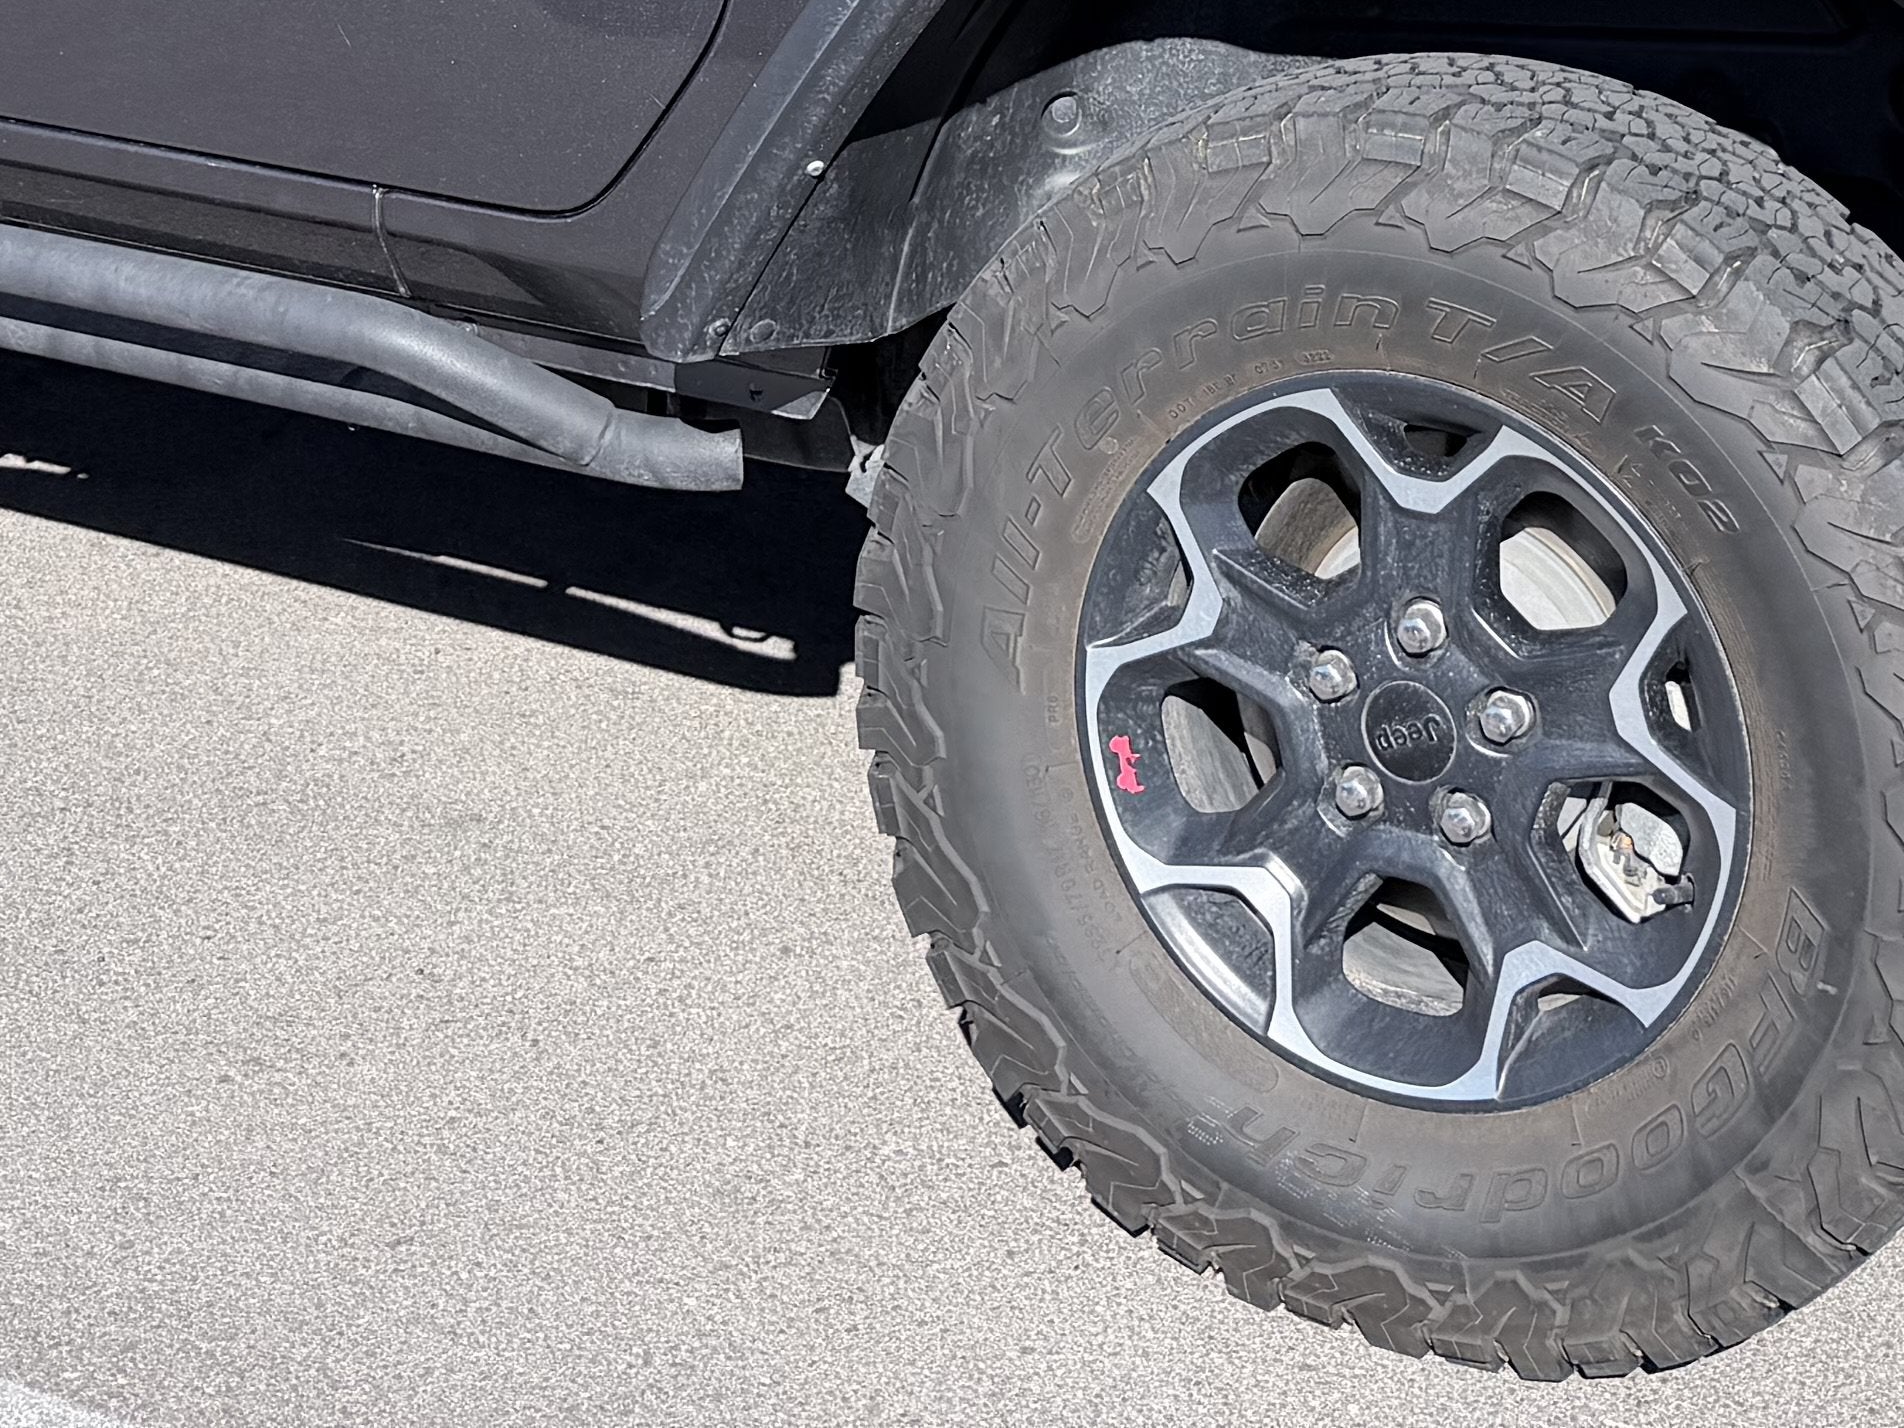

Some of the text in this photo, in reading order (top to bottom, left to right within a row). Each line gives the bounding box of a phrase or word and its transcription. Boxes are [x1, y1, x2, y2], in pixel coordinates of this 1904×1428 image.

[980, 284, 1400, 697] All-Terrain
[1425, 297, 1617, 424] T/A
[1375, 715, 1441, 752] Jeep
[1224, 887, 1831, 1224] BFGoodrich
